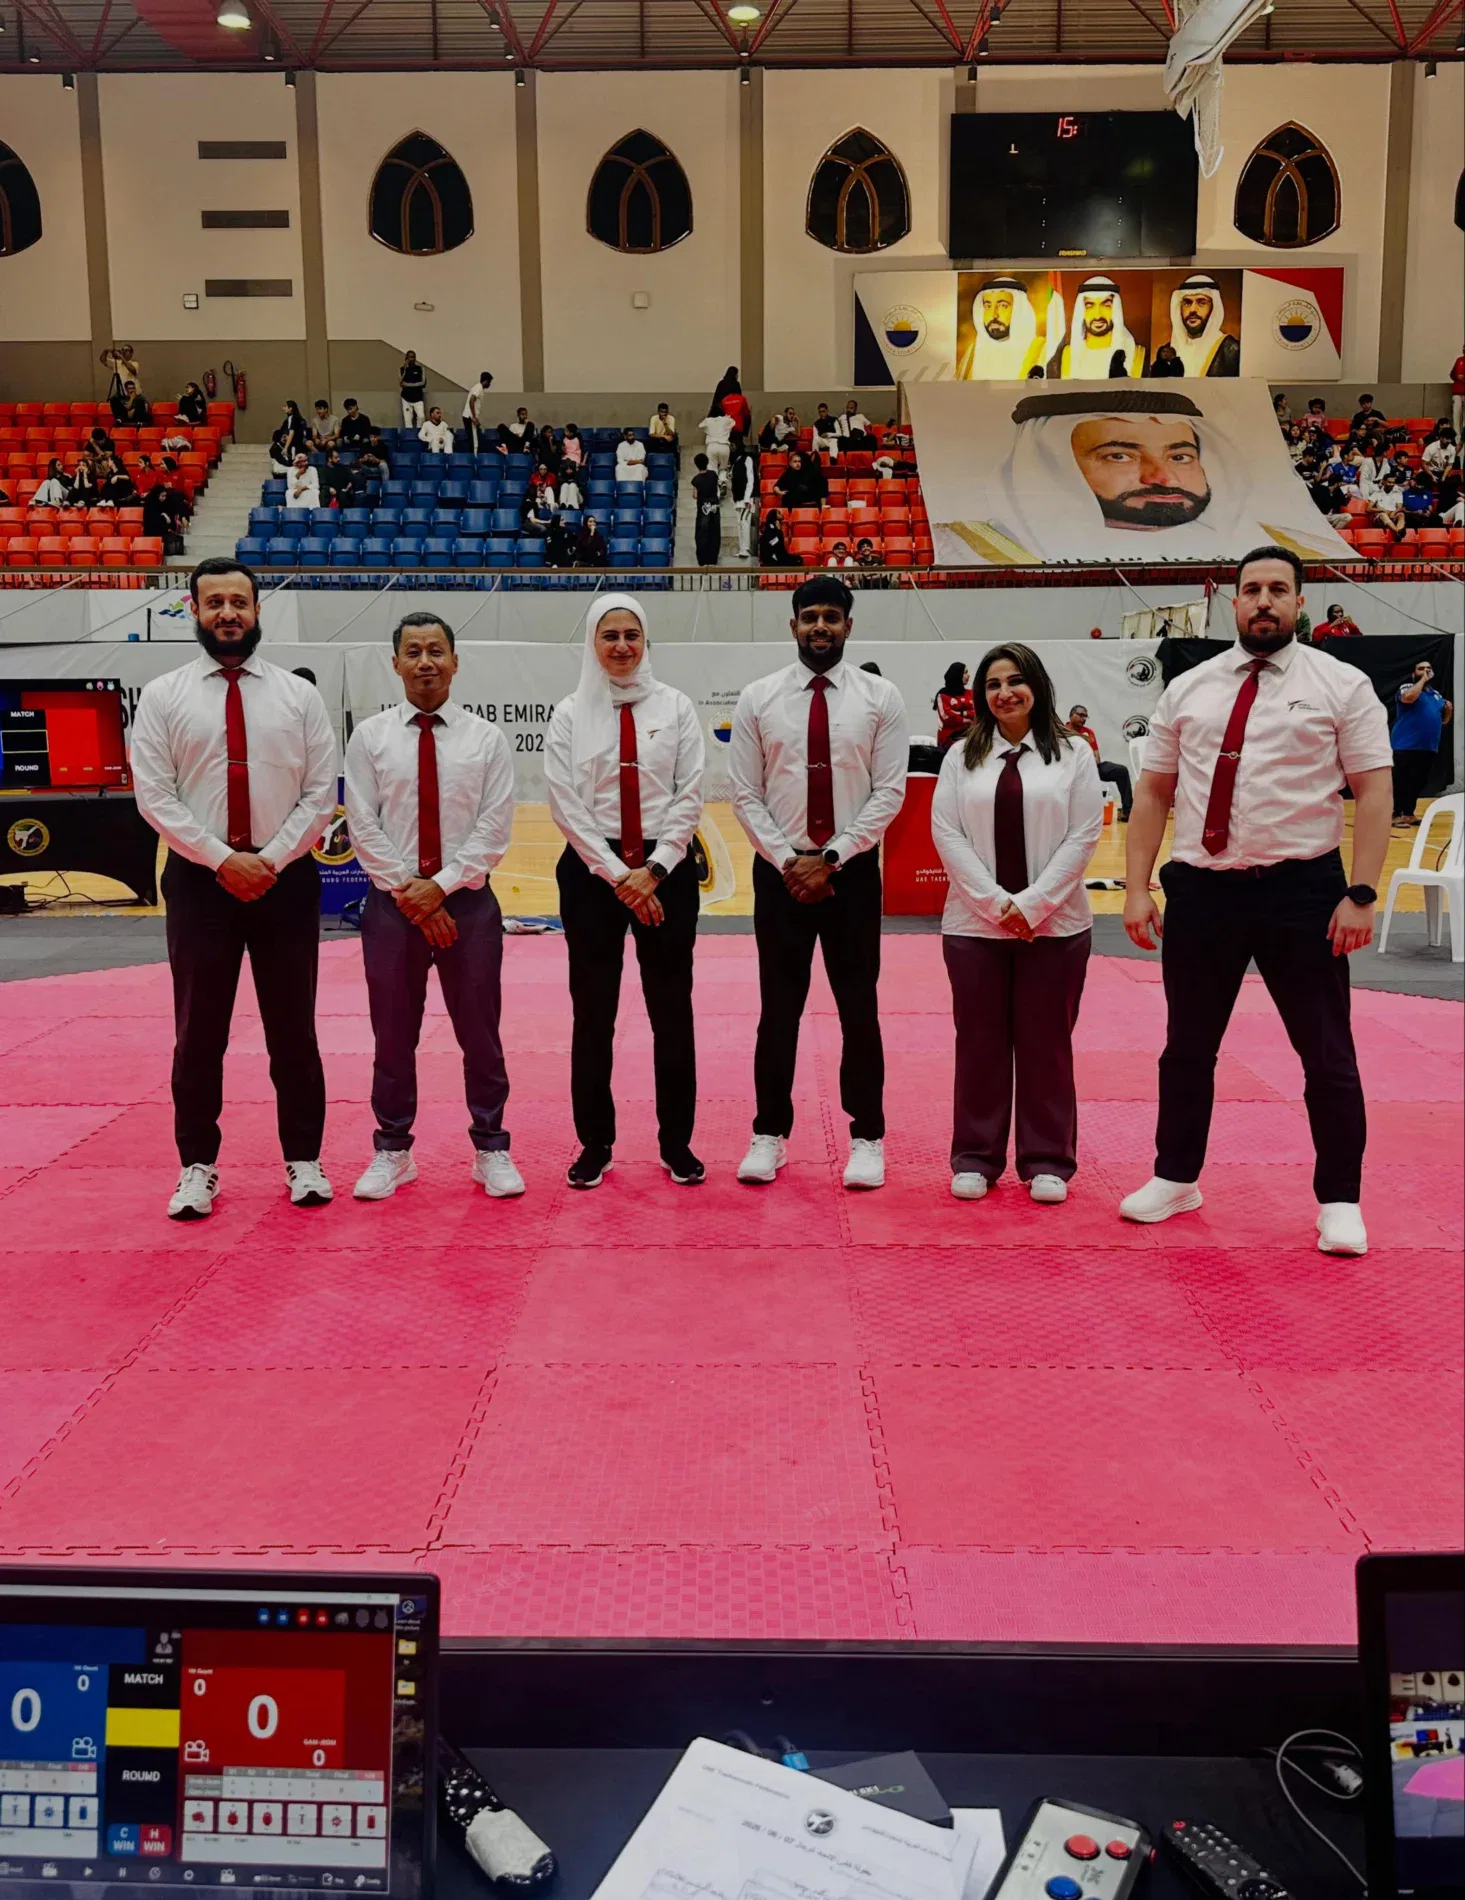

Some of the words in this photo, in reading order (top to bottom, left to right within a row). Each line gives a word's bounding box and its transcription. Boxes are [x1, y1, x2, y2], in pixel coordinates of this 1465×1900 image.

[503, 704, 555, 723] EMIRA
[515, 733, 544, 752] 202
[14, 764, 39, 772] ROUND
[77, 1675, 89, 1691] 0
[124, 1673, 164, 1685] MATCH
[193, 1679, 206, 1696] 0
[11, 1688, 42, 1732] 0
[247, 1695, 279, 1739] 0
[312, 1749, 326, 1766] 0
[121, 1770, 161, 1782] ROUND
[119, 1827, 129, 1838] C
[149, 1828, 159, 1839] H
[113, 1840, 135, 1852] WIN
[143, 1841, 166, 1852] WIN
